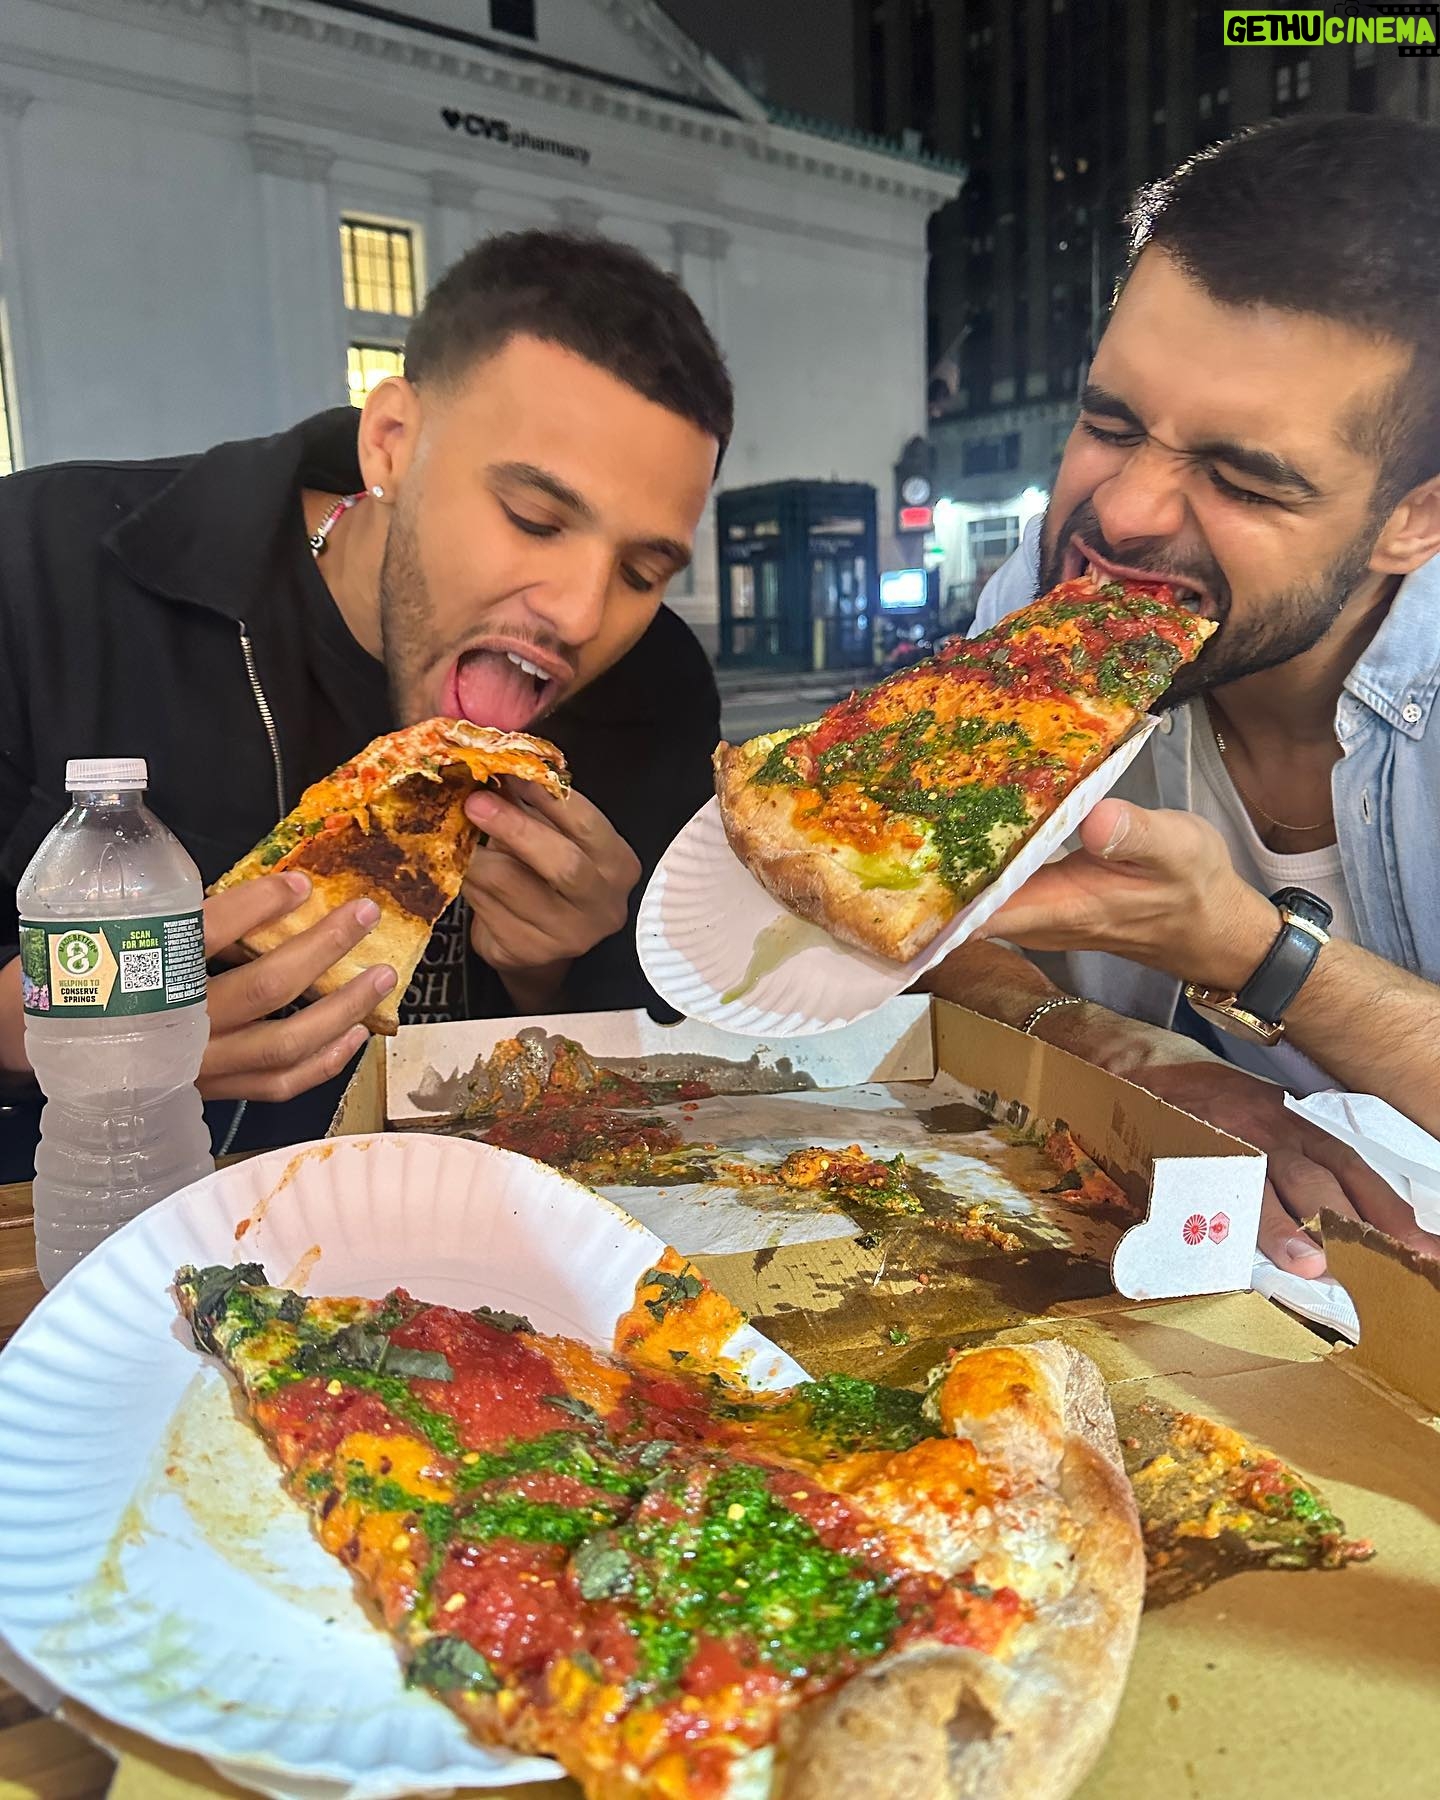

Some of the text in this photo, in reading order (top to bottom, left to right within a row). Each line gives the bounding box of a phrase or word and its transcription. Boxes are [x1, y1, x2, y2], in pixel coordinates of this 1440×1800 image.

[463, 112, 592, 167] CVS pharmacy
[130, 930, 151, 940] SCAN
[122, 940, 137, 949] FOR
[139, 938, 159, 948] MORE
[58, 979, 88, 987] HELPING
[60, 987, 99, 996] CONSERVE
[63, 995, 96, 1003] SPRINGS
